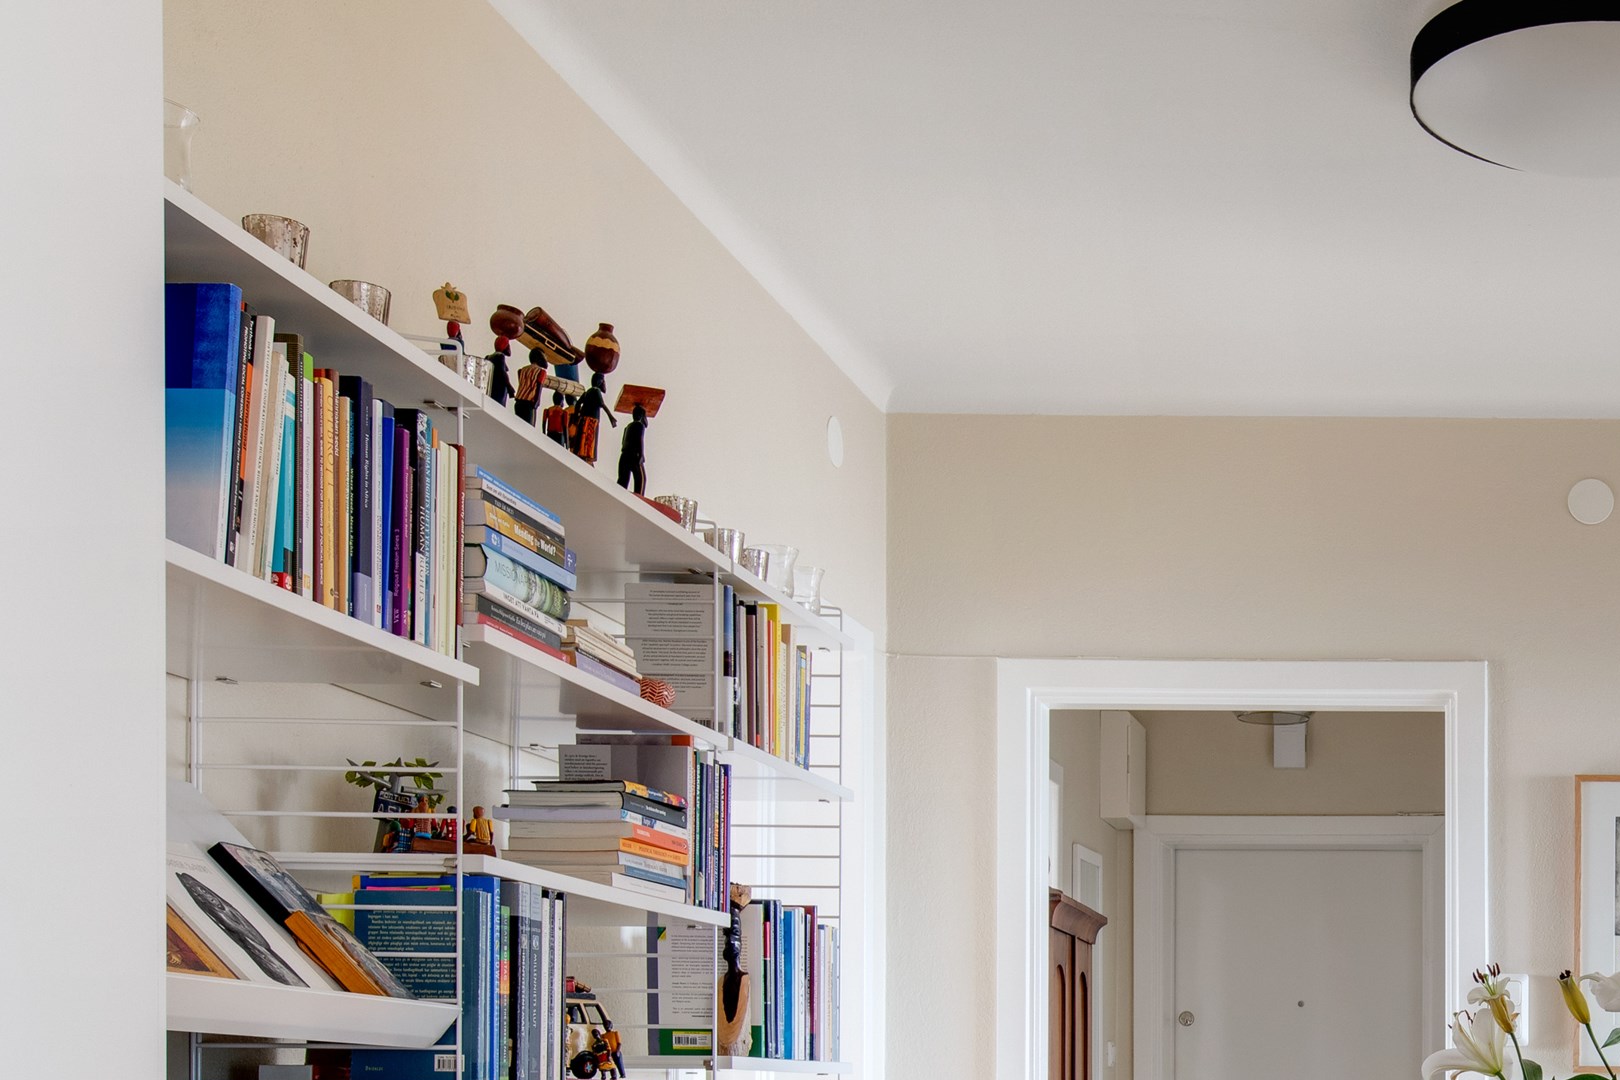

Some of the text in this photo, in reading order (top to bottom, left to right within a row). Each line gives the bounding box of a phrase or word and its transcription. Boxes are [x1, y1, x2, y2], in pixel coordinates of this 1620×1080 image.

[263, 340, 271, 387] DEVELOPMENT
[242, 390, 251, 451] International
[260, 388, 268, 432] COOPERATION
[250, 508, 258, 547] DEMOCRACY
[418, 505, 426, 553] HUMAN
